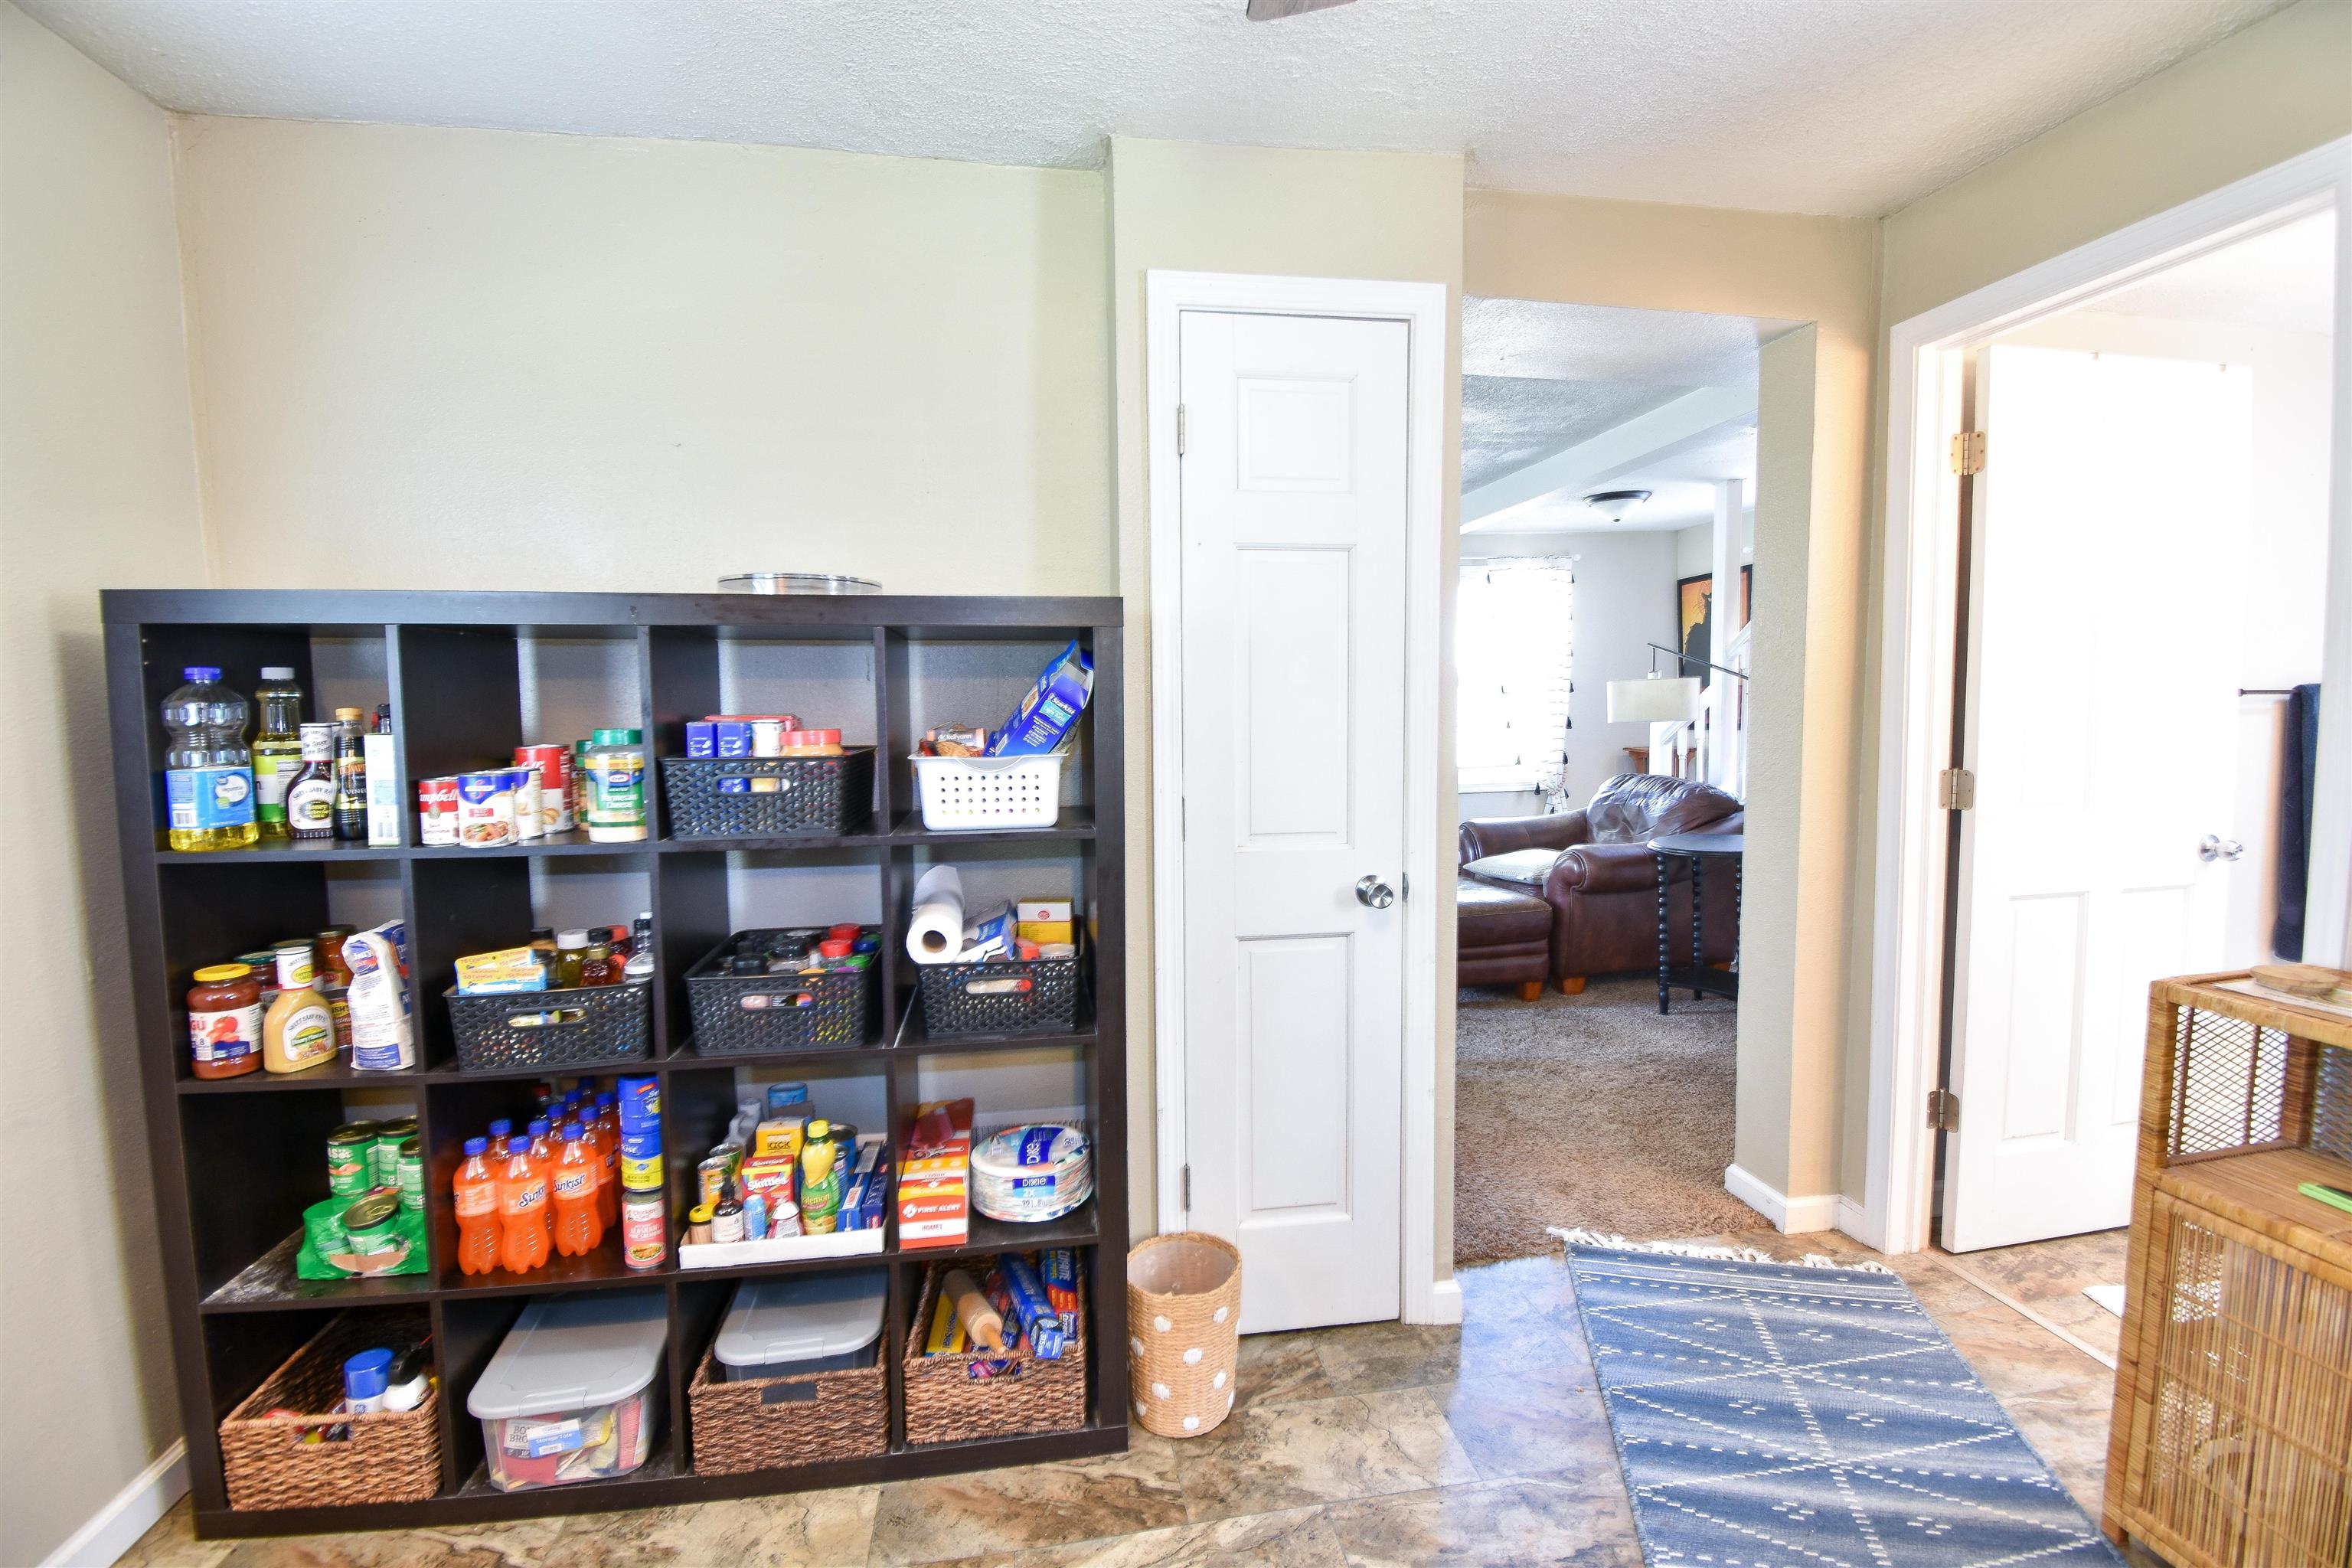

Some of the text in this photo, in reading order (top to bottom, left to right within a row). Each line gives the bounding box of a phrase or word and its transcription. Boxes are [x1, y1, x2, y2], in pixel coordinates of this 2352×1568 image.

[1052, 696, 1076, 715] StarKist
[767, 1141, 791, 1149] KICK
[553, 1174, 586, 1193] Sunkist
[747, 1176, 790, 1191] Skittles
[938, 1203, 962, 1212] ALERT
